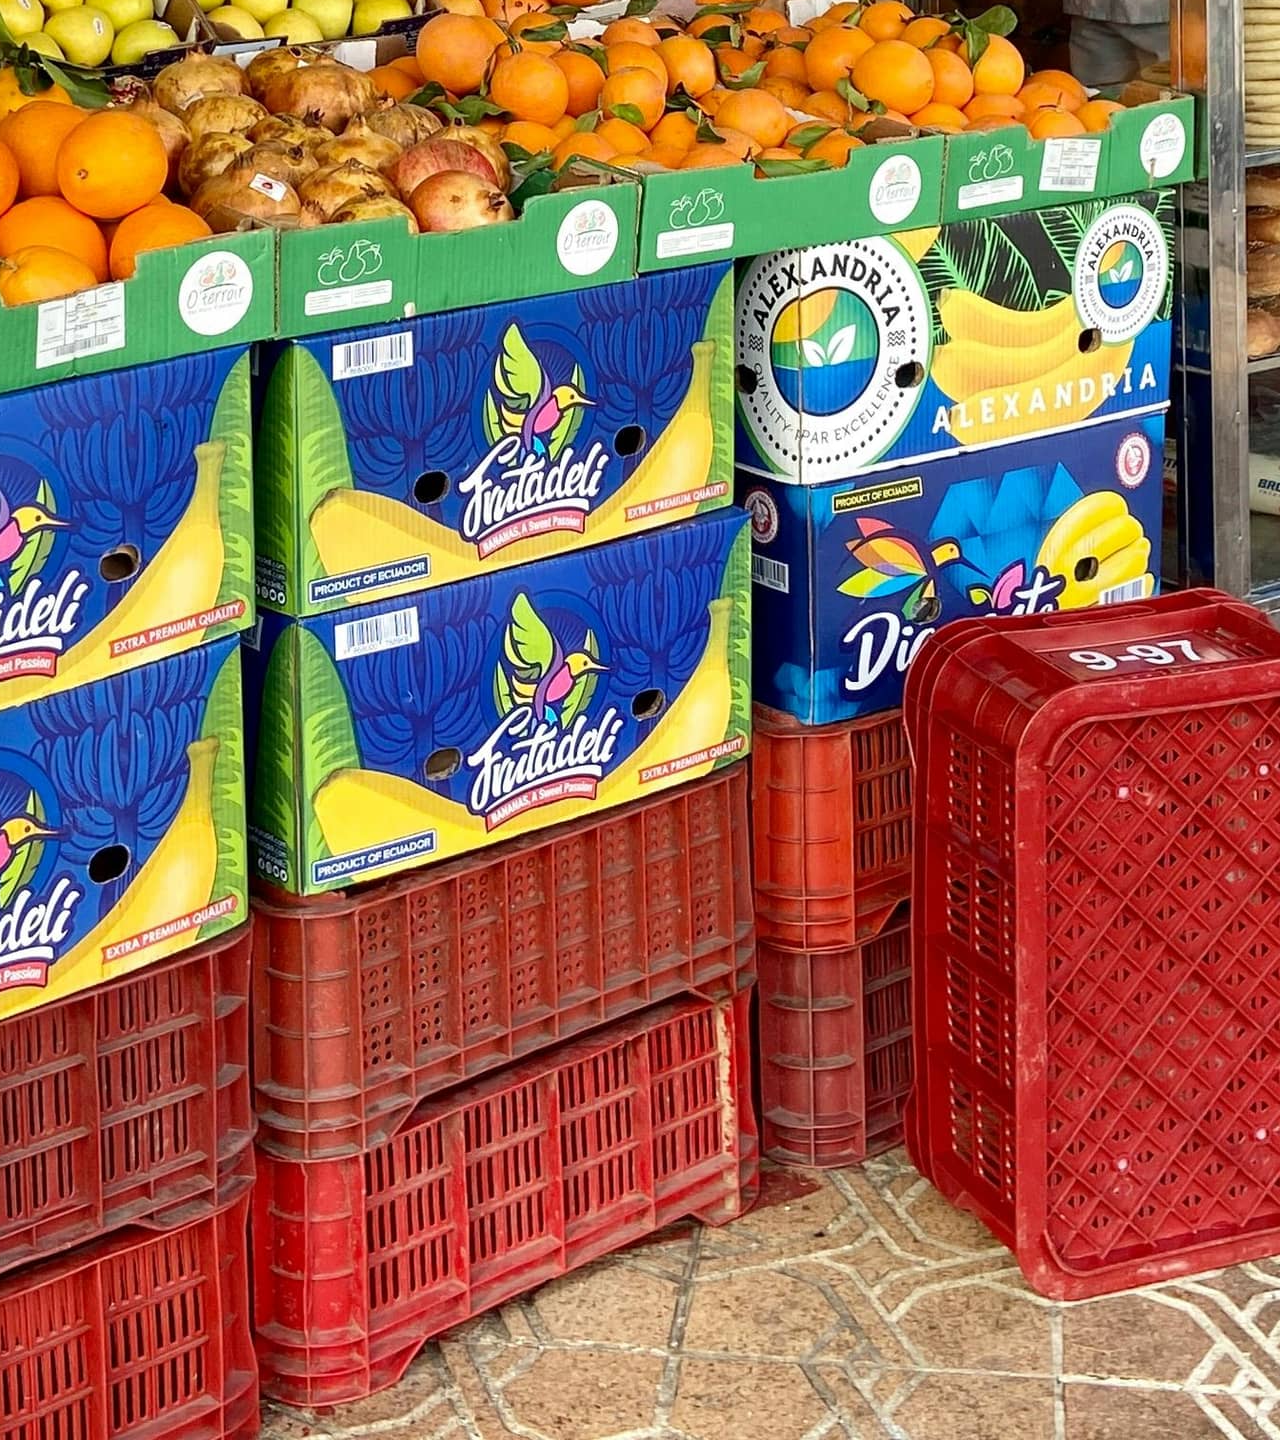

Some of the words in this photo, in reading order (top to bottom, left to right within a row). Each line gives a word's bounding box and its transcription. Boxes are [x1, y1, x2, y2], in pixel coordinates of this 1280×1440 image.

[1088, 223, 1154, 271] ALEXANDRIA
[753, 253, 900, 331] ALEXANDRIA
[835, 355, 900, 441] EXCELLENCE
[930, 362, 1158, 435] ALEXANDRIA
[459, 436, 608, 539] Frutadeli
[628, 505, 653, 519] EXTRA
[654, 495, 691, 513] PREMIUM
[693, 484, 725, 502] QUALITY
[835, 494, 871, 508] PRODUCT
[872, 491, 882, 501] OF
[882, 483, 919, 498] ECUADOR
[314, 576, 361, 595] PRODUCT
[363, 573, 377, 584] OF
[378, 560, 426, 581] ECUADOR
[113, 636, 146, 655] EXTRA
[149, 619, 196, 643] PREMIUM
[199, 601, 241, 626] QUALITY
[15, 657, 51, 672] Passion
[1069, 640, 1201, 670] 9-97
[468, 705, 623, 811] Frutadeli
[642, 765, 667, 780] EXTRA
[669, 750, 709, 774] PREMIUM
[709, 739, 743, 759] QUALITY
[318, 855, 365, 876] PRODUCT
[367, 850, 382, 864] OF
[383, 837, 431, 859] ECUADOR
[106, 940, 140, 961] EXTRA
[142, 917, 190, 947] PREMIUM
[191, 899, 236, 929] QUALITY
[4, 967, 41, 984] Passion
